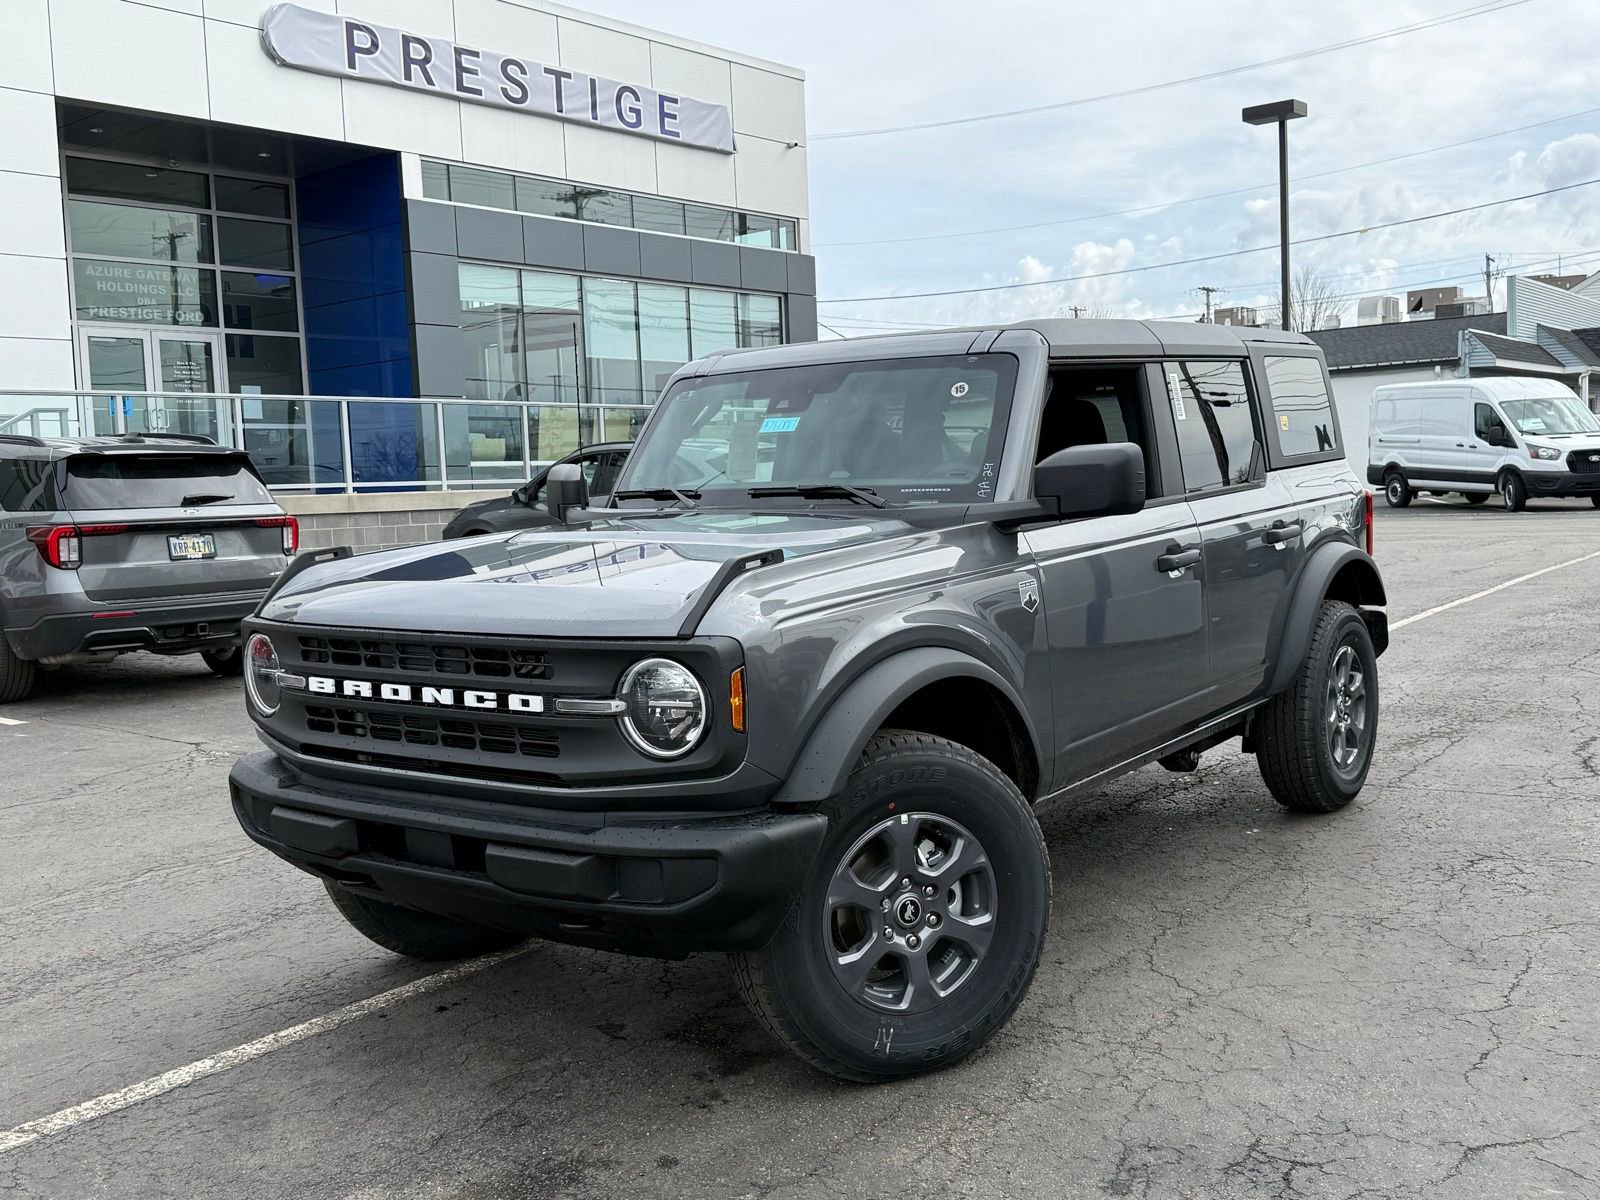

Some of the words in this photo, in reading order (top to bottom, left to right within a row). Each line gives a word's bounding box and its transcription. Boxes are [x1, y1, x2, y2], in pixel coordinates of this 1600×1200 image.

[345, 20, 681, 139] PRESTIGE
[85, 265, 133, 279] AZURE
[136, 269, 198, 283] GATEWAY
[96, 281, 167, 295] HOLDINGS
[137, 297, 157, 305] DBA
[88, 305, 162, 320] PRESTIGE
[167, 310, 204, 322] FORD
[954, 384, 966, 395] 15
[977, 462, 994, 498] AA-29
[308, 676, 544, 713] BRONCO
